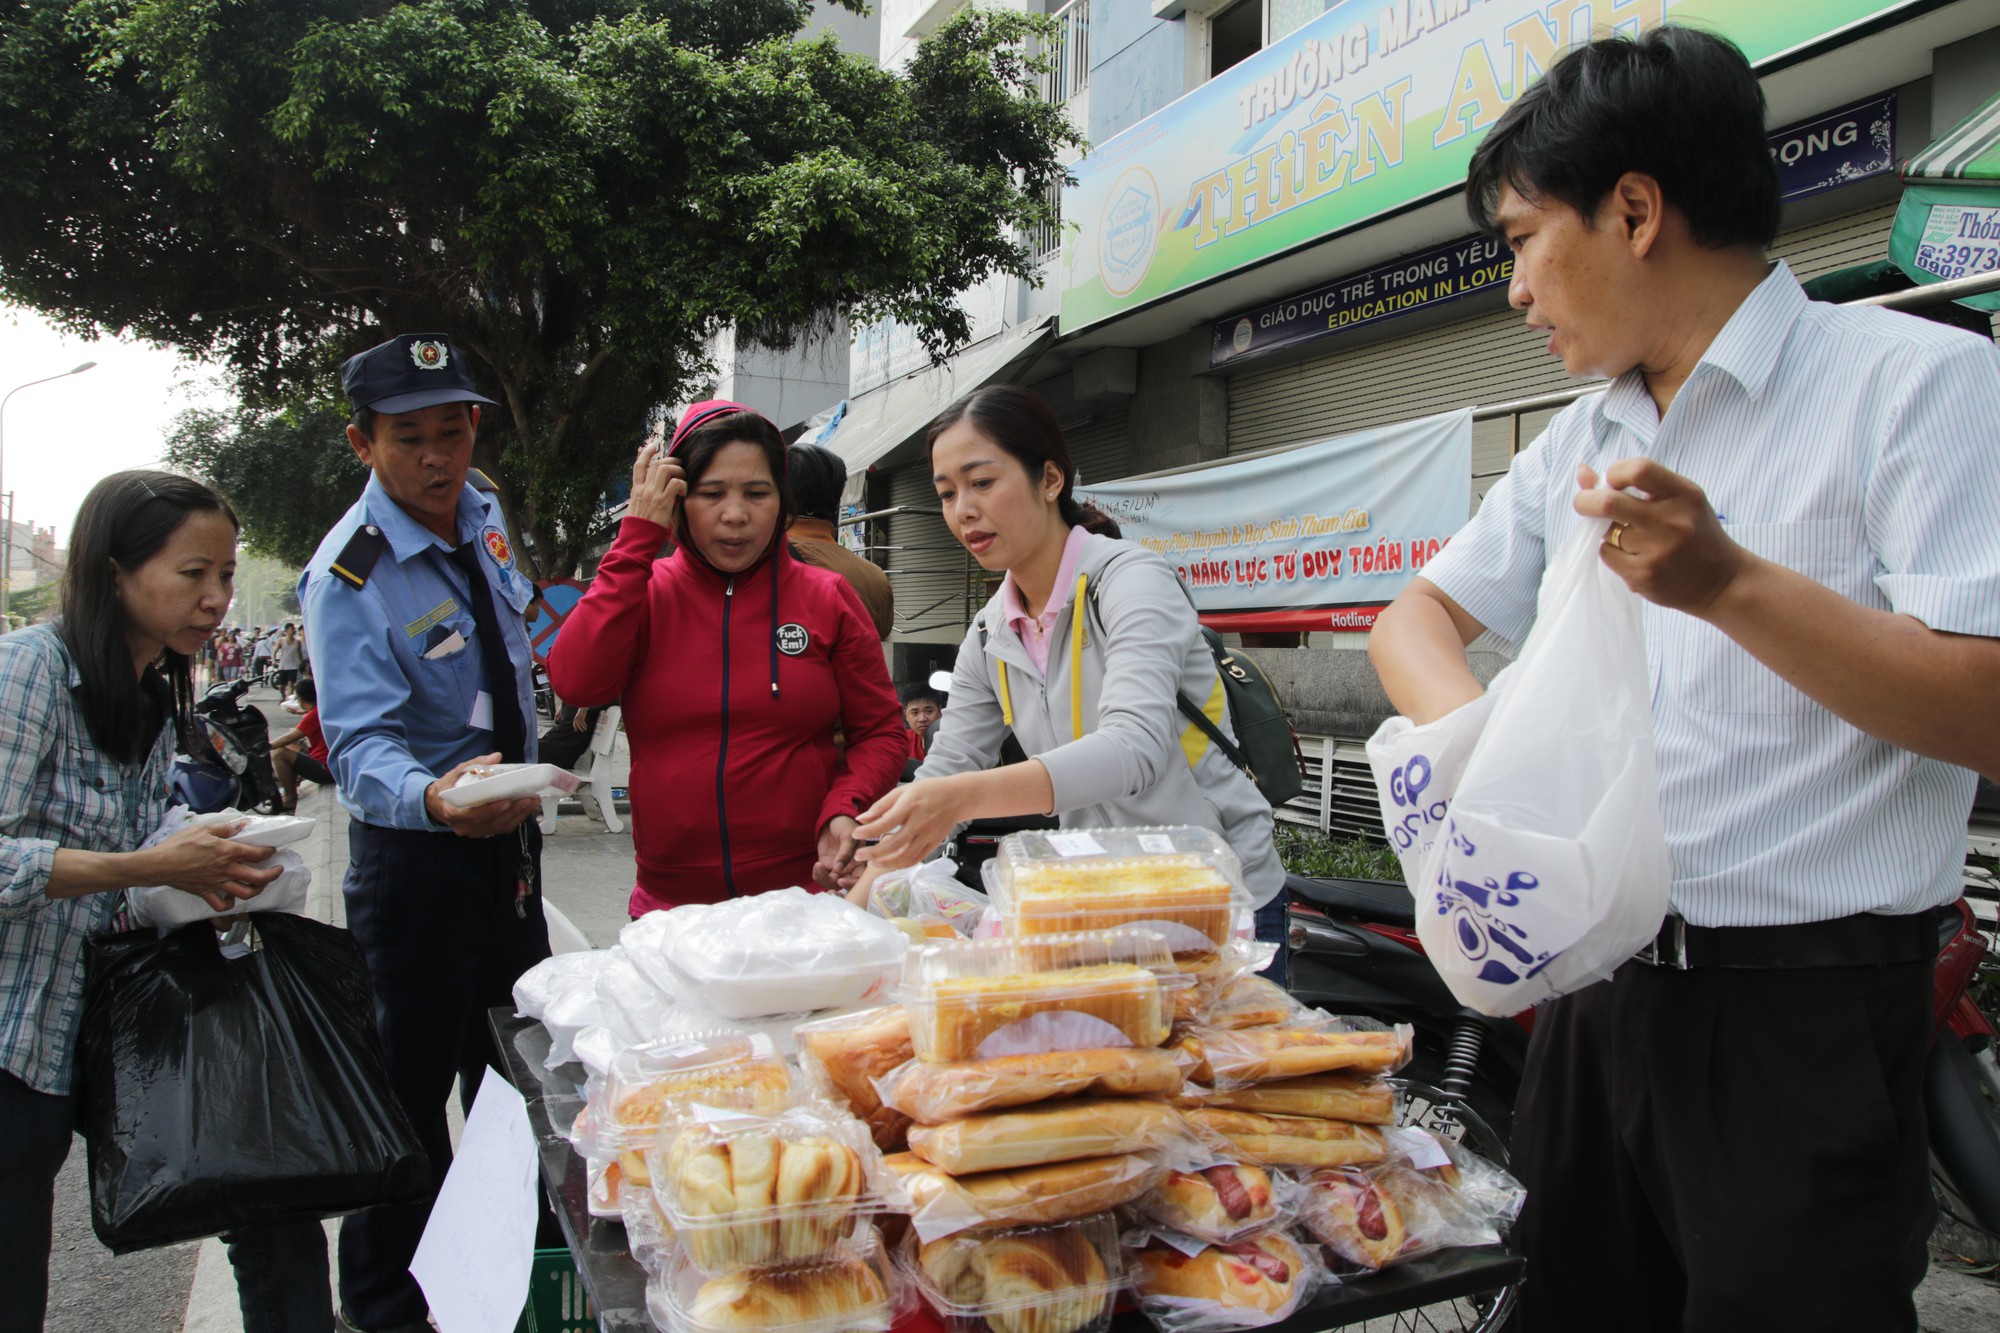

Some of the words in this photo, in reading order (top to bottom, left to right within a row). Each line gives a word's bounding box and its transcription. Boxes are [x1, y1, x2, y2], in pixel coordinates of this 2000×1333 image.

[1239, 23, 1369, 130] TRƯỜNG
[1260, 305, 1297, 328] GIÁO
[1302, 293, 1336, 316] DỤC
[1341, 274, 1375, 303] TRẺ
[1381, 257, 1449, 291] TRONG
[1456, 240, 1499, 268] YÊU
[1328, 287, 1428, 328] EDUCATION
[1434, 279, 1452, 298] IN
[1460, 260, 1513, 291] LOVE
[1192, 528, 1228, 552] Huynh
[1231, 525, 1242, 543] &
[1244, 523, 1267, 548] Học
[1269, 518, 1298, 540] Sinh
[1300, 515, 1340, 535] Tham
[1190, 556, 1231, 586] NĂNG
[1235, 556, 1267, 588] LỰC
[1273, 548, 1298, 580] TƯ
[1302, 549, 1342, 578] DUY
[1349, 536, 1402, 575] TOÁN
[779, 625, 804, 639] Fuck
[781, 638, 804, 649] Em!
